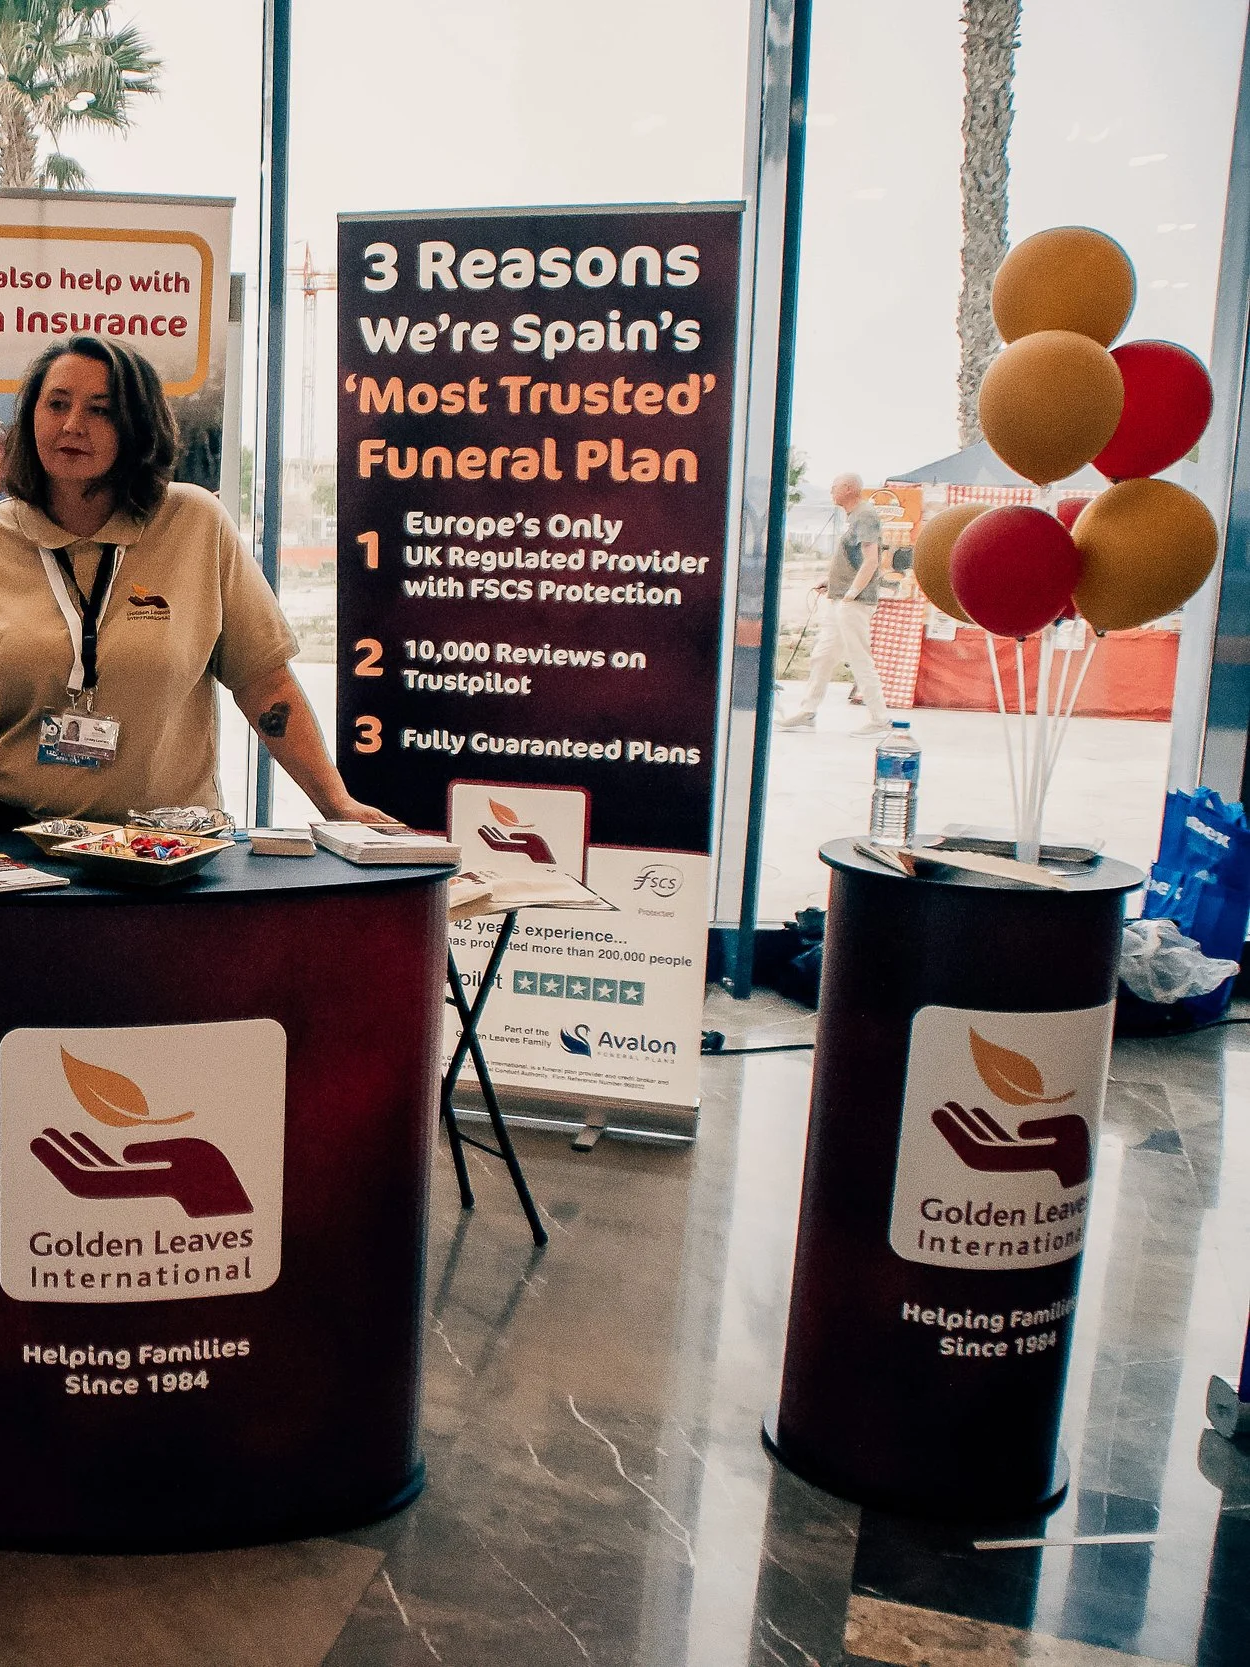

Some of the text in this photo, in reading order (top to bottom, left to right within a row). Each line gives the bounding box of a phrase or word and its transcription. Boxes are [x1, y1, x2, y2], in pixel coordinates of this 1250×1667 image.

[60, 268, 122, 295] help
[129, 270, 190, 293] with
[364, 241, 700, 292] 3 Reasons
[15, 306, 188, 337] Insurance
[360, 310, 700, 360] We’re Spain’s
[358, 438, 697, 482] Funeral Plan
[406, 511, 623, 544] Europe’s Only
[357, 530, 379, 569] 1
[405, 546, 709, 574] UK Regulated Provider
[405, 577, 681, 605] with FSCS Protection
[354, 638, 383, 677] 2
[405, 640, 646, 669] 10,000 Reviews on
[404, 670, 532, 695] Trustpilot
[355, 715, 382, 753] 3
[403, 729, 700, 765] Fully Guaranteed Plans
[454, 918, 472, 930] 42
[477, 922, 520, 935] yeas
[470, 939, 528, 952] protted
[532, 944, 563, 955] more
[567, 945, 594, 958] than
[649, 955, 692, 969] people
[455, 1030, 552, 1048] Gen Leaves Family
[505, 1025, 549, 1037] Part of the
[598, 1031, 677, 1055] Avalon
[921, 1196, 1087, 1227] Golden Leave
[30, 1229, 253, 1257] Golden Leaves
[31, 1257, 252, 1289] International
[902, 1302, 1004, 1333] Helping
[22, 1338, 251, 1370] Helping Families
[939, 1330, 1056, 1357] Since 1984
[65, 1369, 209, 1395] Since 1984
